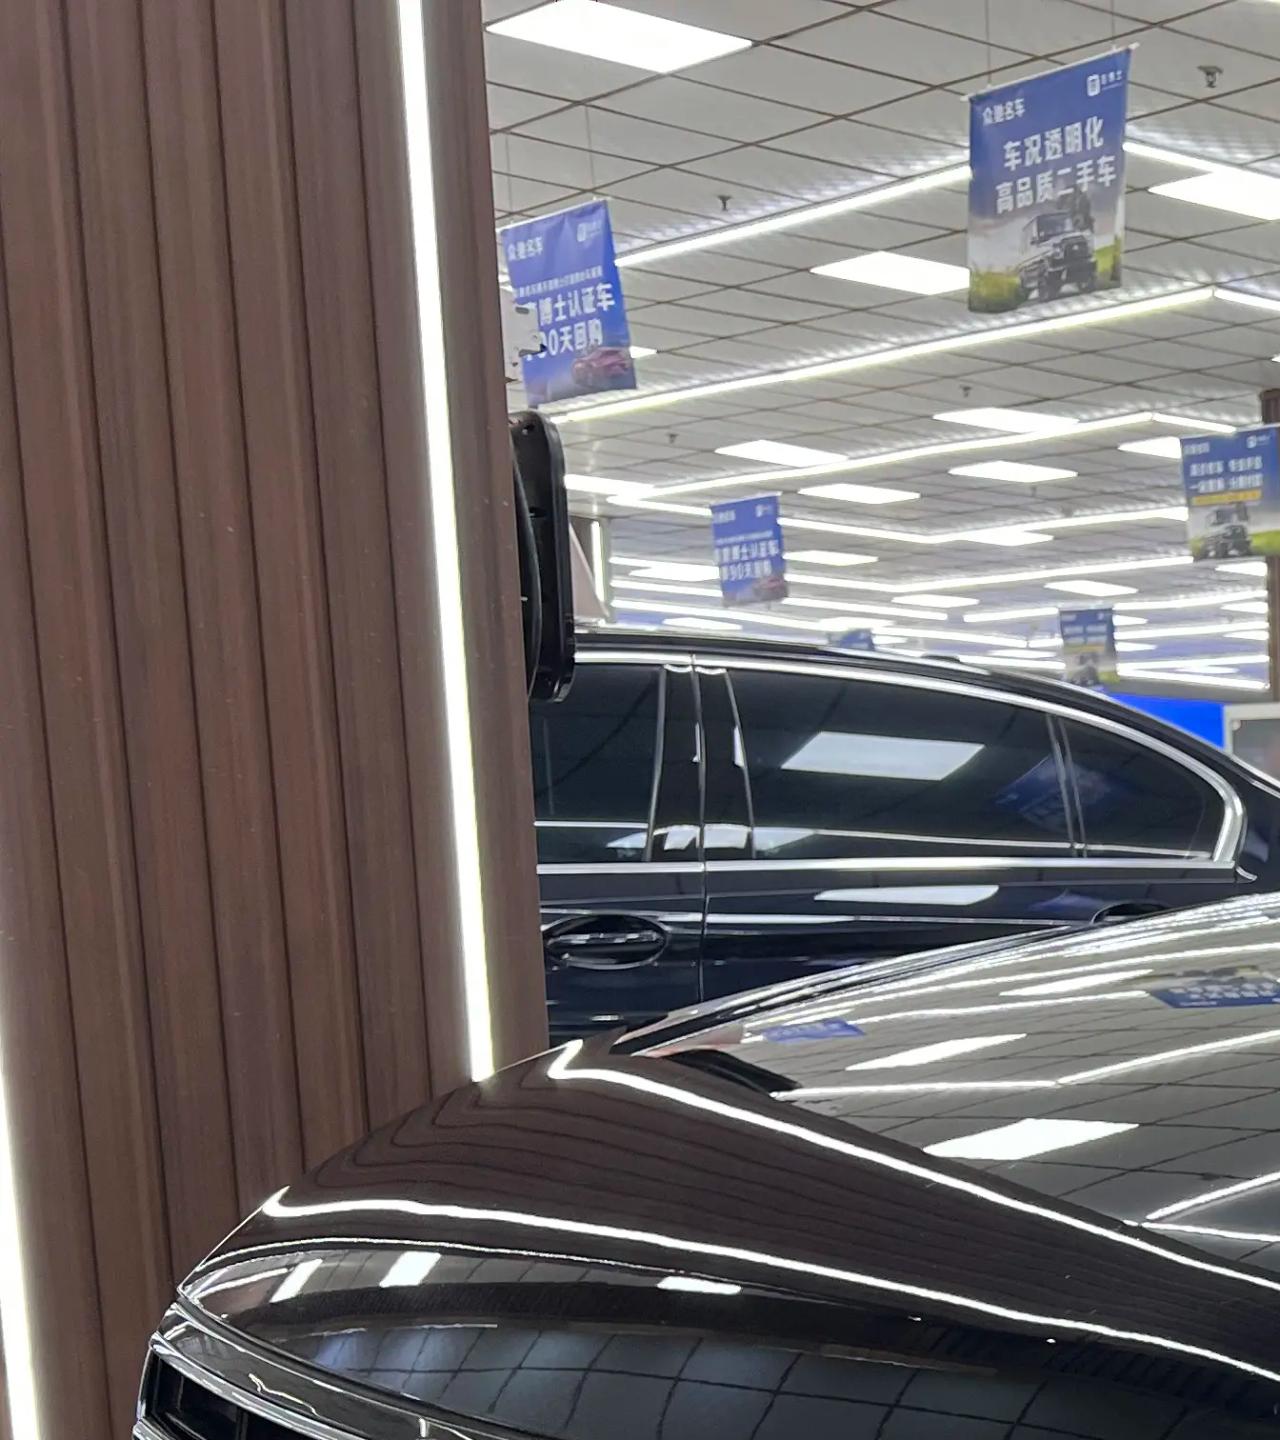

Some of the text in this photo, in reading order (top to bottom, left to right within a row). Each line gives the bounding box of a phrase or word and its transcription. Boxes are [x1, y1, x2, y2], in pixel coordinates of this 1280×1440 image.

[1003, 116, 1104, 171] 车况透明化
[995, 155, 1117, 214] 高品质二手车
[527, 282, 616, 327] 博士认证车
[526, 318, 604, 361] 90天回购
